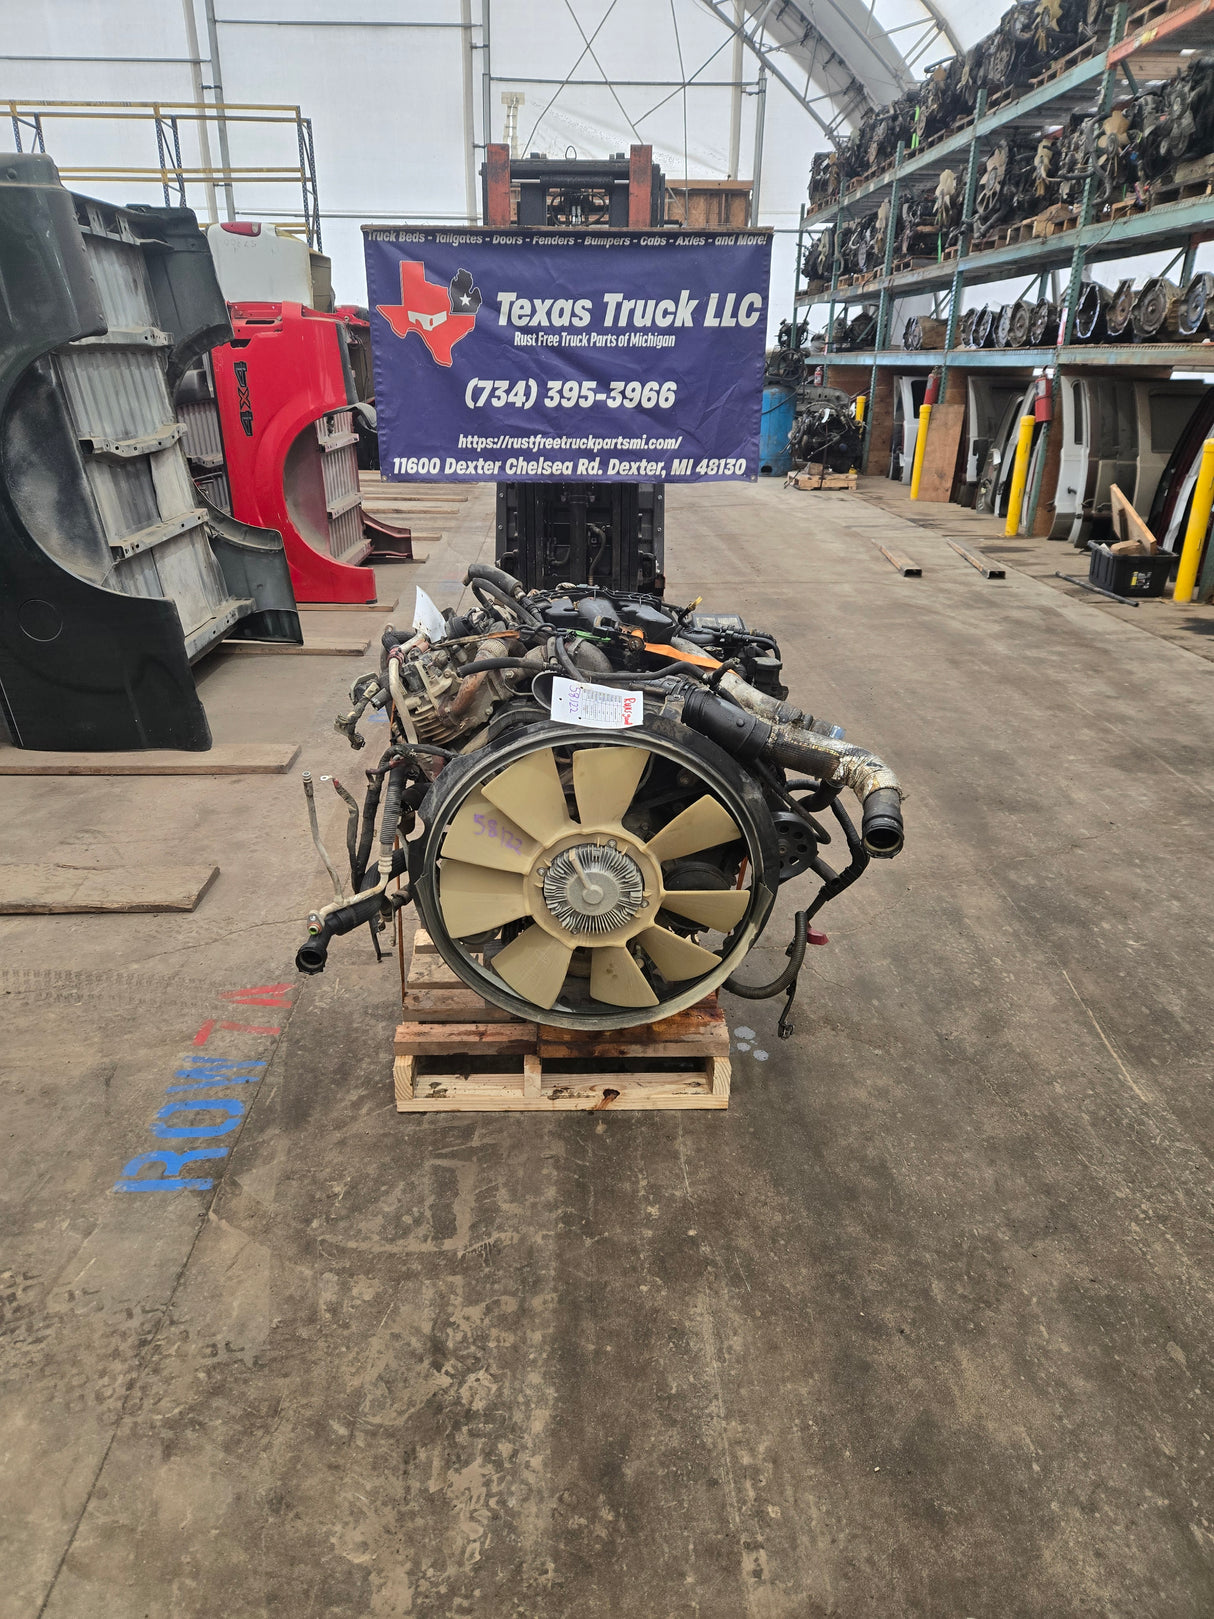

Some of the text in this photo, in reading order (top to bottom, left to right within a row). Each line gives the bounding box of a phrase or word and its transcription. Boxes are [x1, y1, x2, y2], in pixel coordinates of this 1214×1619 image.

[367, 230, 396, 242] Truck
[399, 231, 425, 243] Beds
[435, 232, 483, 247] Tailgates
[492, 234, 523, 244] Doors
[533, 235, 575, 245] Fenders
[584, 236, 630, 248] Bumpers
[640, 235, 667, 246] Cabs
[675, 235, 705, 246] Axles
[715, 235, 734, 246] and
[737, 233, 767, 245] More!
[497, 290, 763, 328] Texas Truck LLC
[514, 332, 676, 349] Rust Free Truck Parts of Michigan
[464, 377, 678, 410] (734) 395-3966
[458, 434, 682, 453] https://rustfreetruckpartsmi.com/
[393, 457, 747, 479] 11600 Dexter Chelsea Rd. Dexter, MI 48130
[569, 685, 582, 714] 58122
[112, 1055, 267, 1192] ROW
